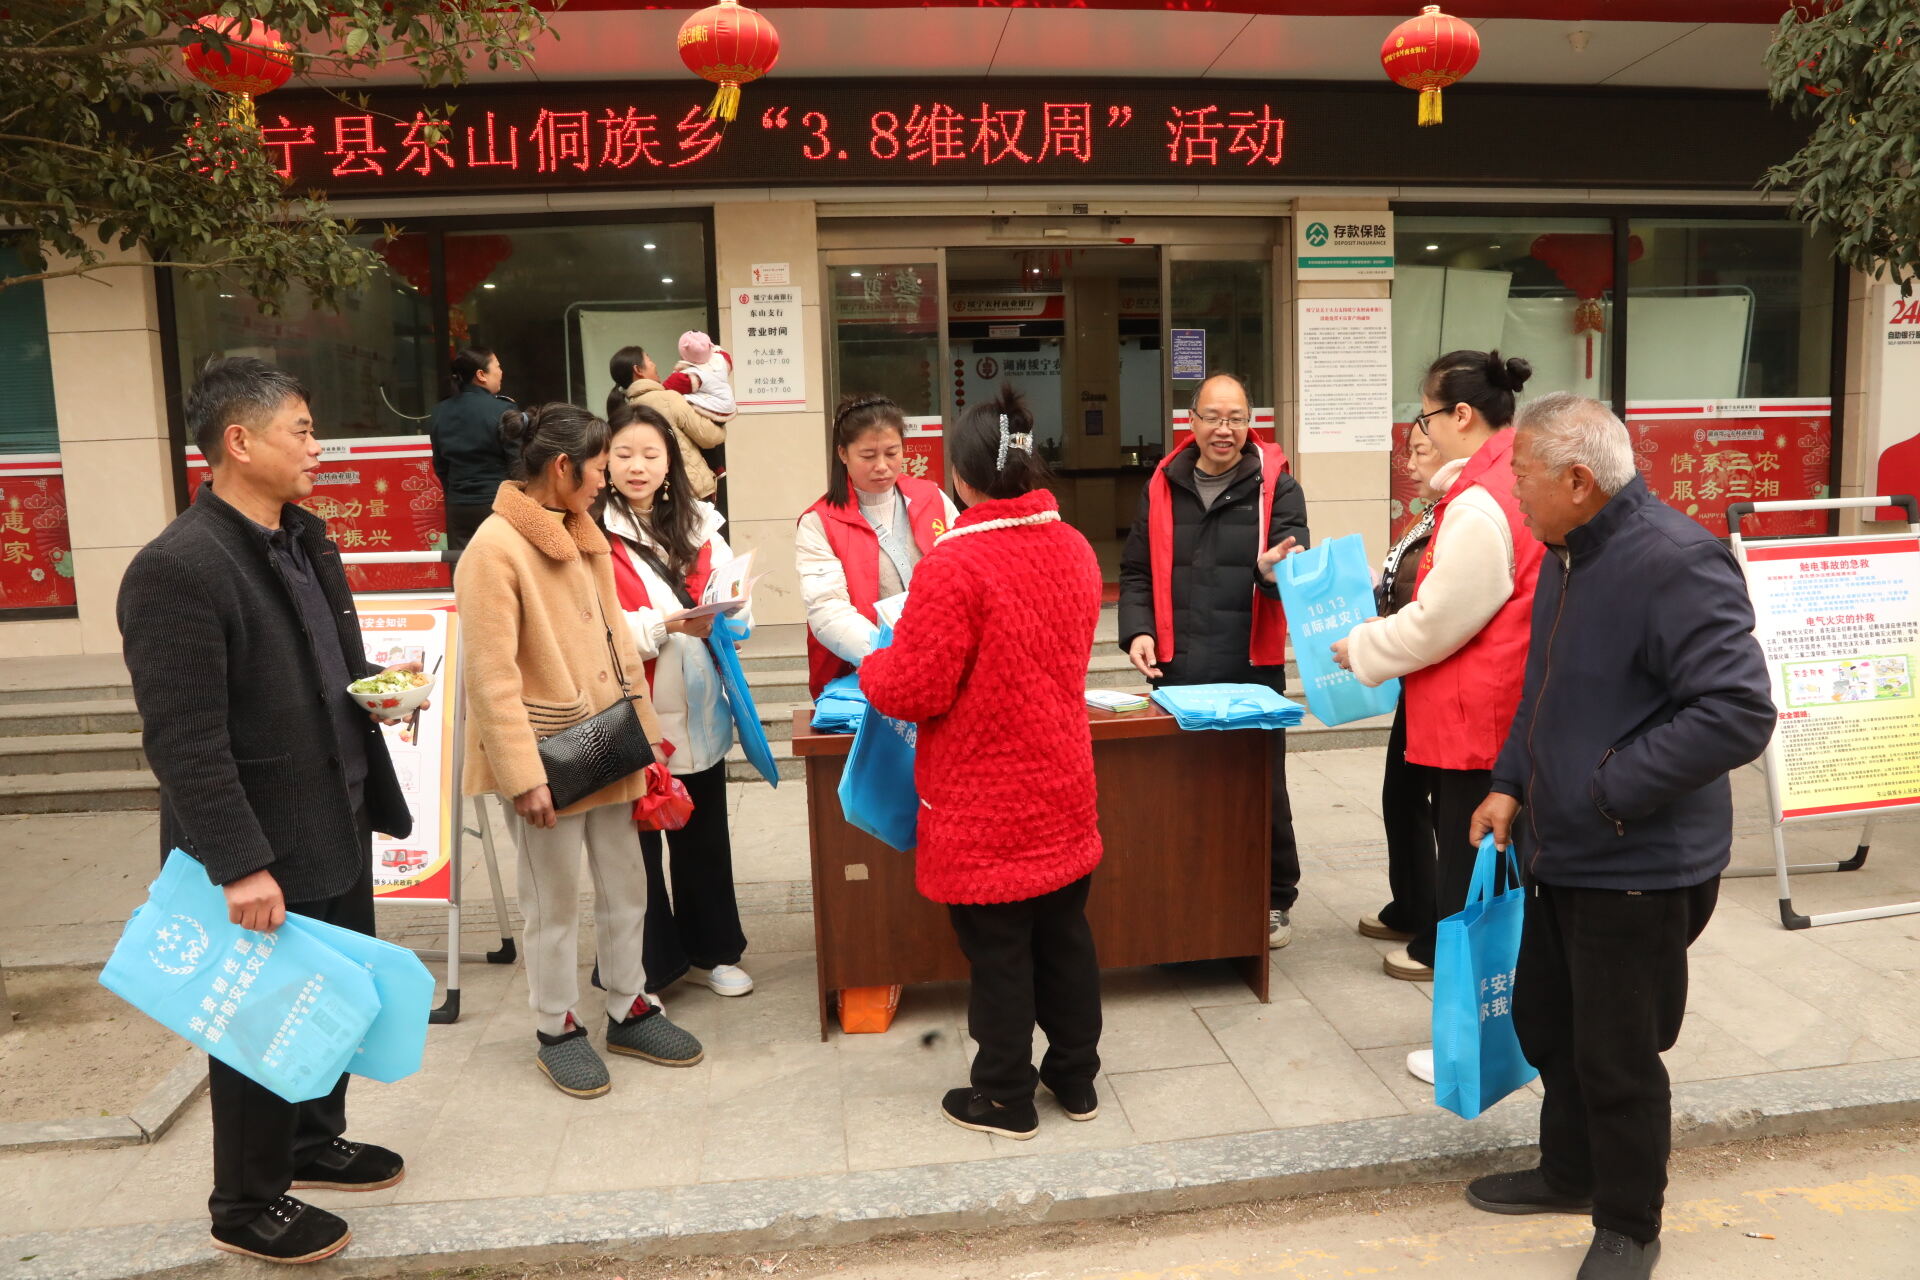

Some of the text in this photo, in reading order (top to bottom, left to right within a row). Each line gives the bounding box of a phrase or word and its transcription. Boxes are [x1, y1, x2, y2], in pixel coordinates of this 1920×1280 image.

[187, 101, 1286, 178] 宁县东山侗族乡“3.8维权周”活动
[1333, 225, 1386, 239] 存款保险
[750, 309, 784, 318] 东山支行
[747, 327, 788, 337] 营业时间
[753, 348, 784, 356] 个人业务
[754, 377, 785, 385] 对公业务
[1670, 451, 1781, 474] 情系三农
[1669, 478, 1780, 501] 服务三湘
[301, 499, 389, 521] 融力量
[3, 540, 34, 564] 家
[1799, 558, 1870, 572] 触电事故的急救
[1307, 596, 1346, 617] 10.13
[1806, 613, 1876, 626] 电气火灾的扑救
[882, 712, 917, 749] 家的
[187, 931, 257, 1034] 投资韧性建
[204, 930, 280, 1044] 提升防灾减灾能力
